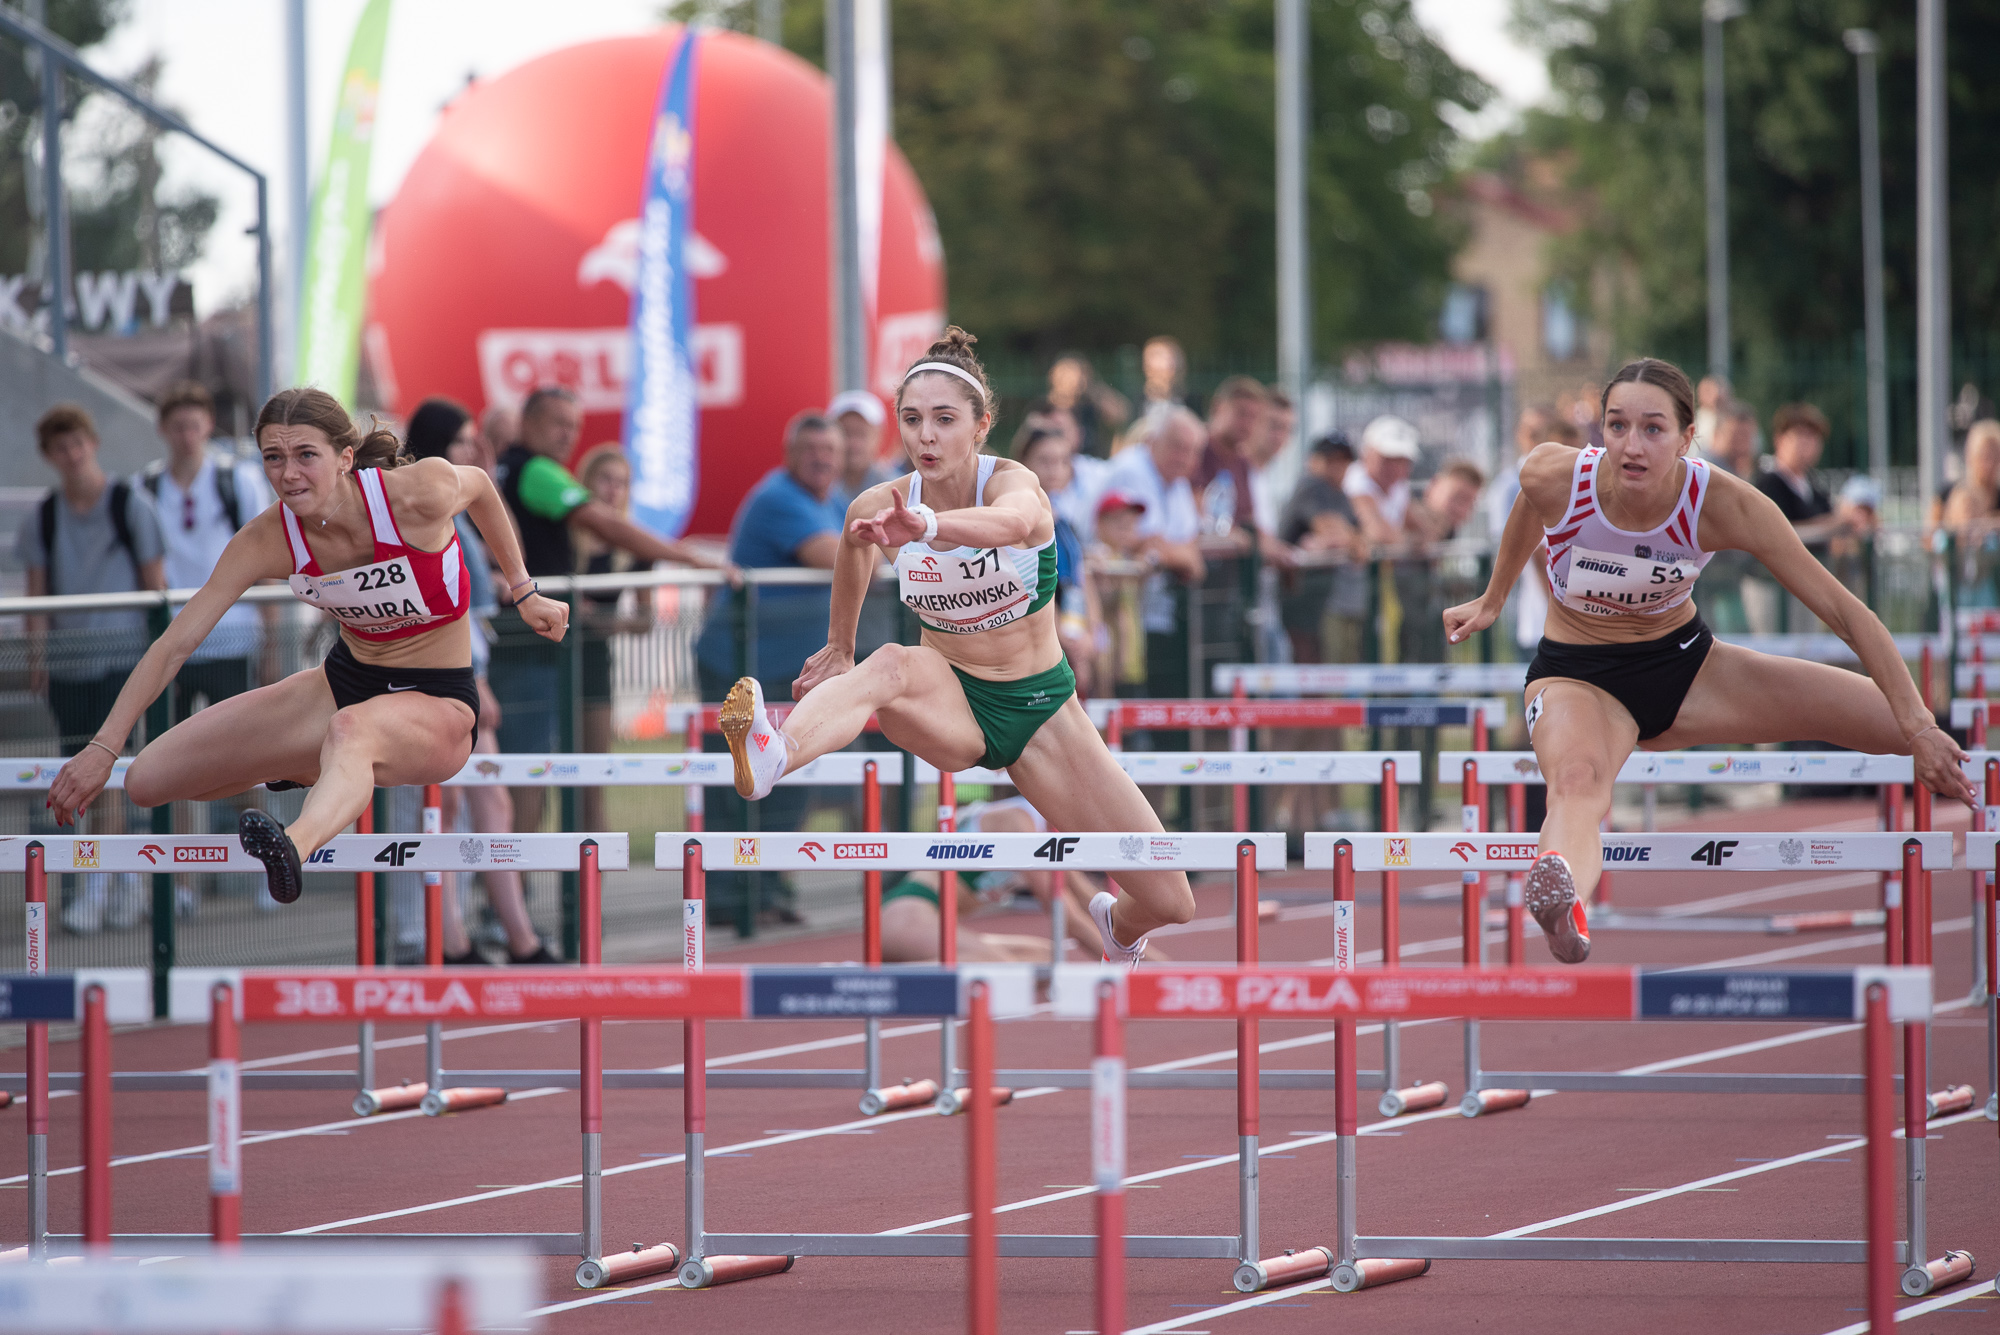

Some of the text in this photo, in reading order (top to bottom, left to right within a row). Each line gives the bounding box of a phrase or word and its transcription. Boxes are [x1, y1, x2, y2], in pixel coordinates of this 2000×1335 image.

[958, 547, 1000, 580] 177
[1576, 559, 1628, 577] 4MOVE
[354, 563, 406, 592] 228
[910, 572, 940, 581] ORLEN
[1650, 565, 1684, 584] 53
[906, 581, 1019, 612] SKIERKOWSKA
[936, 610, 1014, 633] SUWAŁKI 2021
[176, 849, 225, 860] ORLEN
[374, 842, 421, 866] 4F
[836, 846, 885, 857] ORLEN
[926, 844, 995, 859] 4MOVE
[1034, 838, 1080, 862] 4F
[1489, 846, 1538, 858] ORLEN
[1691, 841, 1739, 866] 4F
[74, 858, 98, 866] PZLA
[736, 856, 759, 864] PZLA
[1385, 856, 1408, 864] PZLA
[353, 979, 475, 1015] PZLA
[1236, 976, 1361, 1011] PZLA
